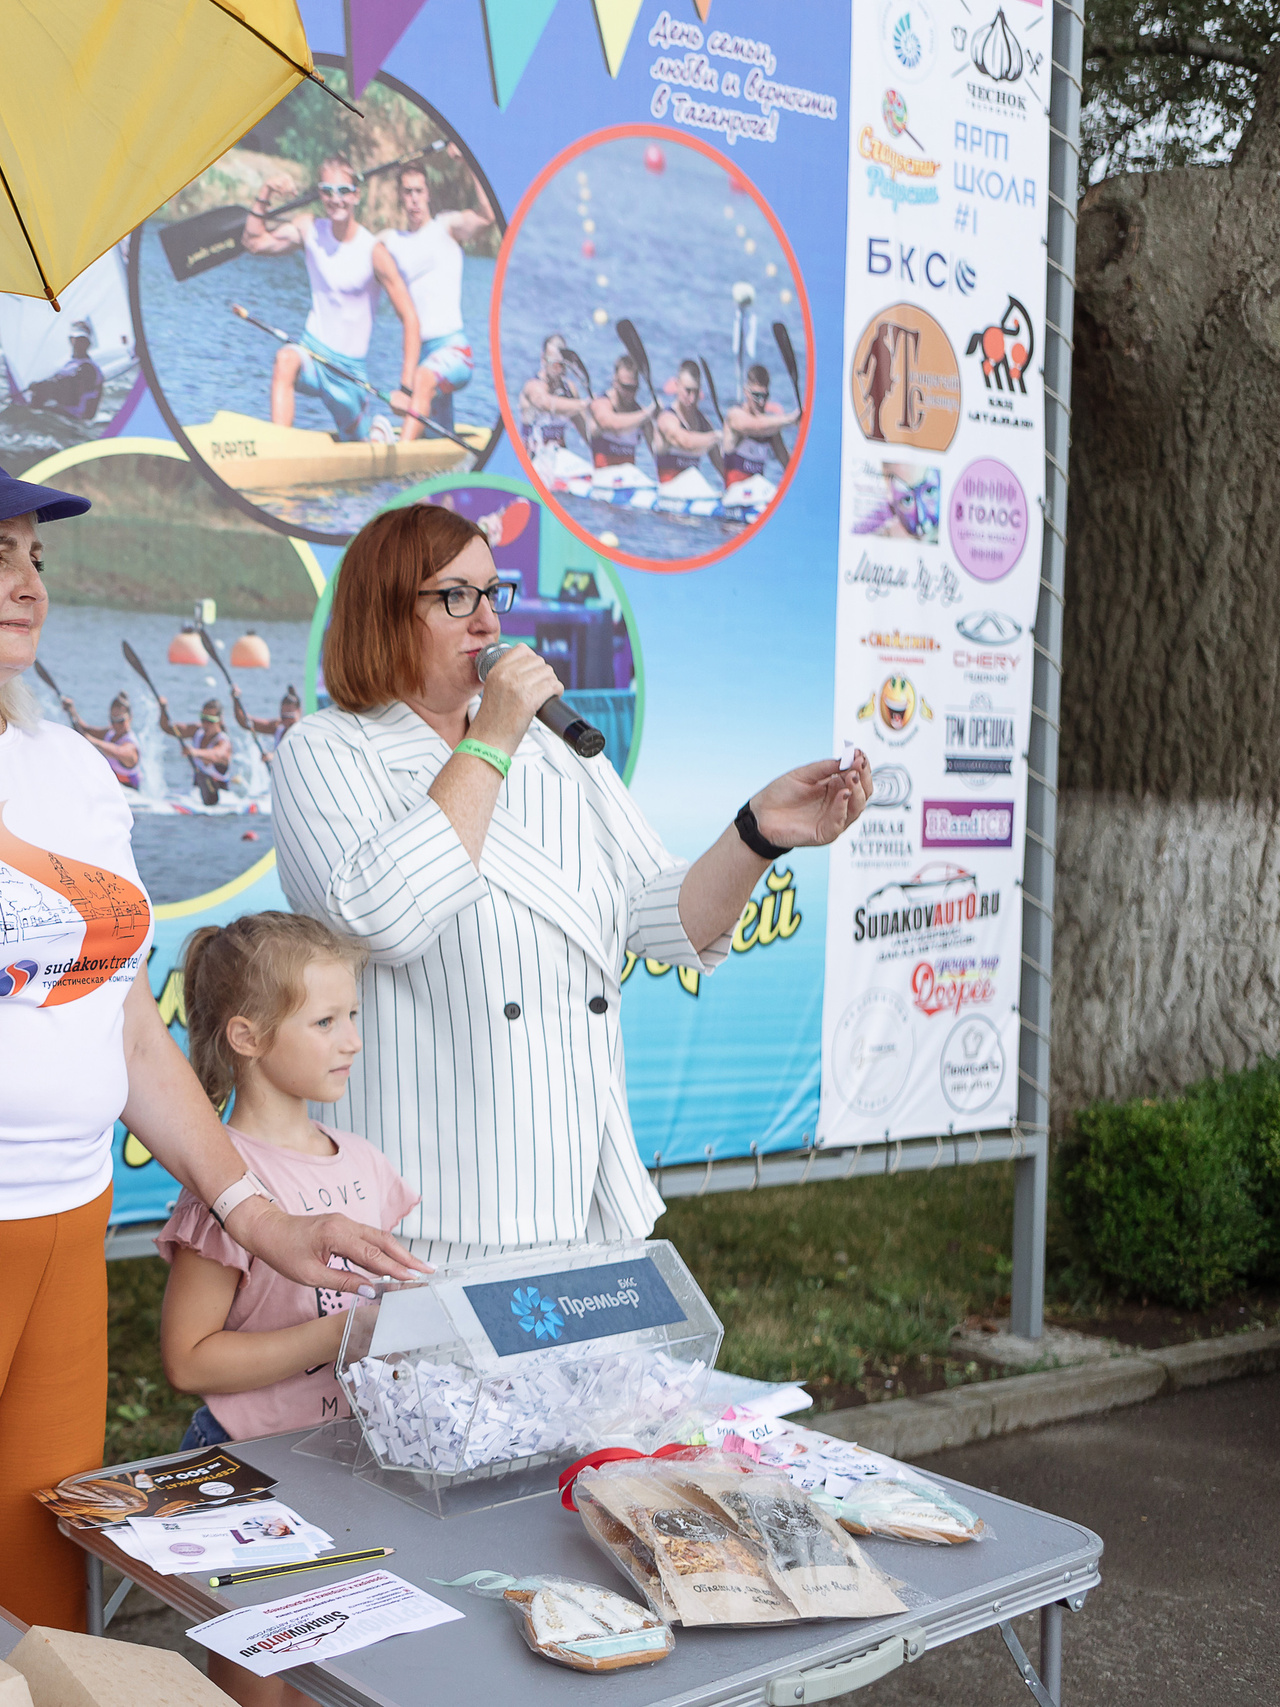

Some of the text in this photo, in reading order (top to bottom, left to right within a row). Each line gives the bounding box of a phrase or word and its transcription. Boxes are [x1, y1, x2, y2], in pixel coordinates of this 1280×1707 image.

[651, 13, 775, 73] День семьи,
[652, 55, 835, 118] любви и верности
[967, 82, 1026, 111] ЧЕСНОК
[652, 85, 777, 143] в Таганроге!
[955, 121, 1008, 161] АРТ
[953, 162, 1035, 207] ШКОЛА
[955, 203, 977, 234] #1
[868, 238, 947, 288] БКС
[968, 504, 1021, 528] ГОЛОС
[952, 650, 1021, 670] CHERY
[945, 715, 965, 746] ТРИ
[969, 718, 1014, 748] ОРЕШКА
[859, 820, 905, 838] ДИКАЯ
[850, 840, 912, 857] УСТРИЦА
[42, 973, 135, 989] туристическая компани
[298, 1181, 365, 1212] LOVE
[617, 1277, 637, 1289] БКС
[558, 1289, 640, 1318] Премьер
[165, 1468, 236, 1489] СЕРТИФИКАТ
[176, 1468, 210, 1480] 500
[230, 1530, 255, 1544] 1
